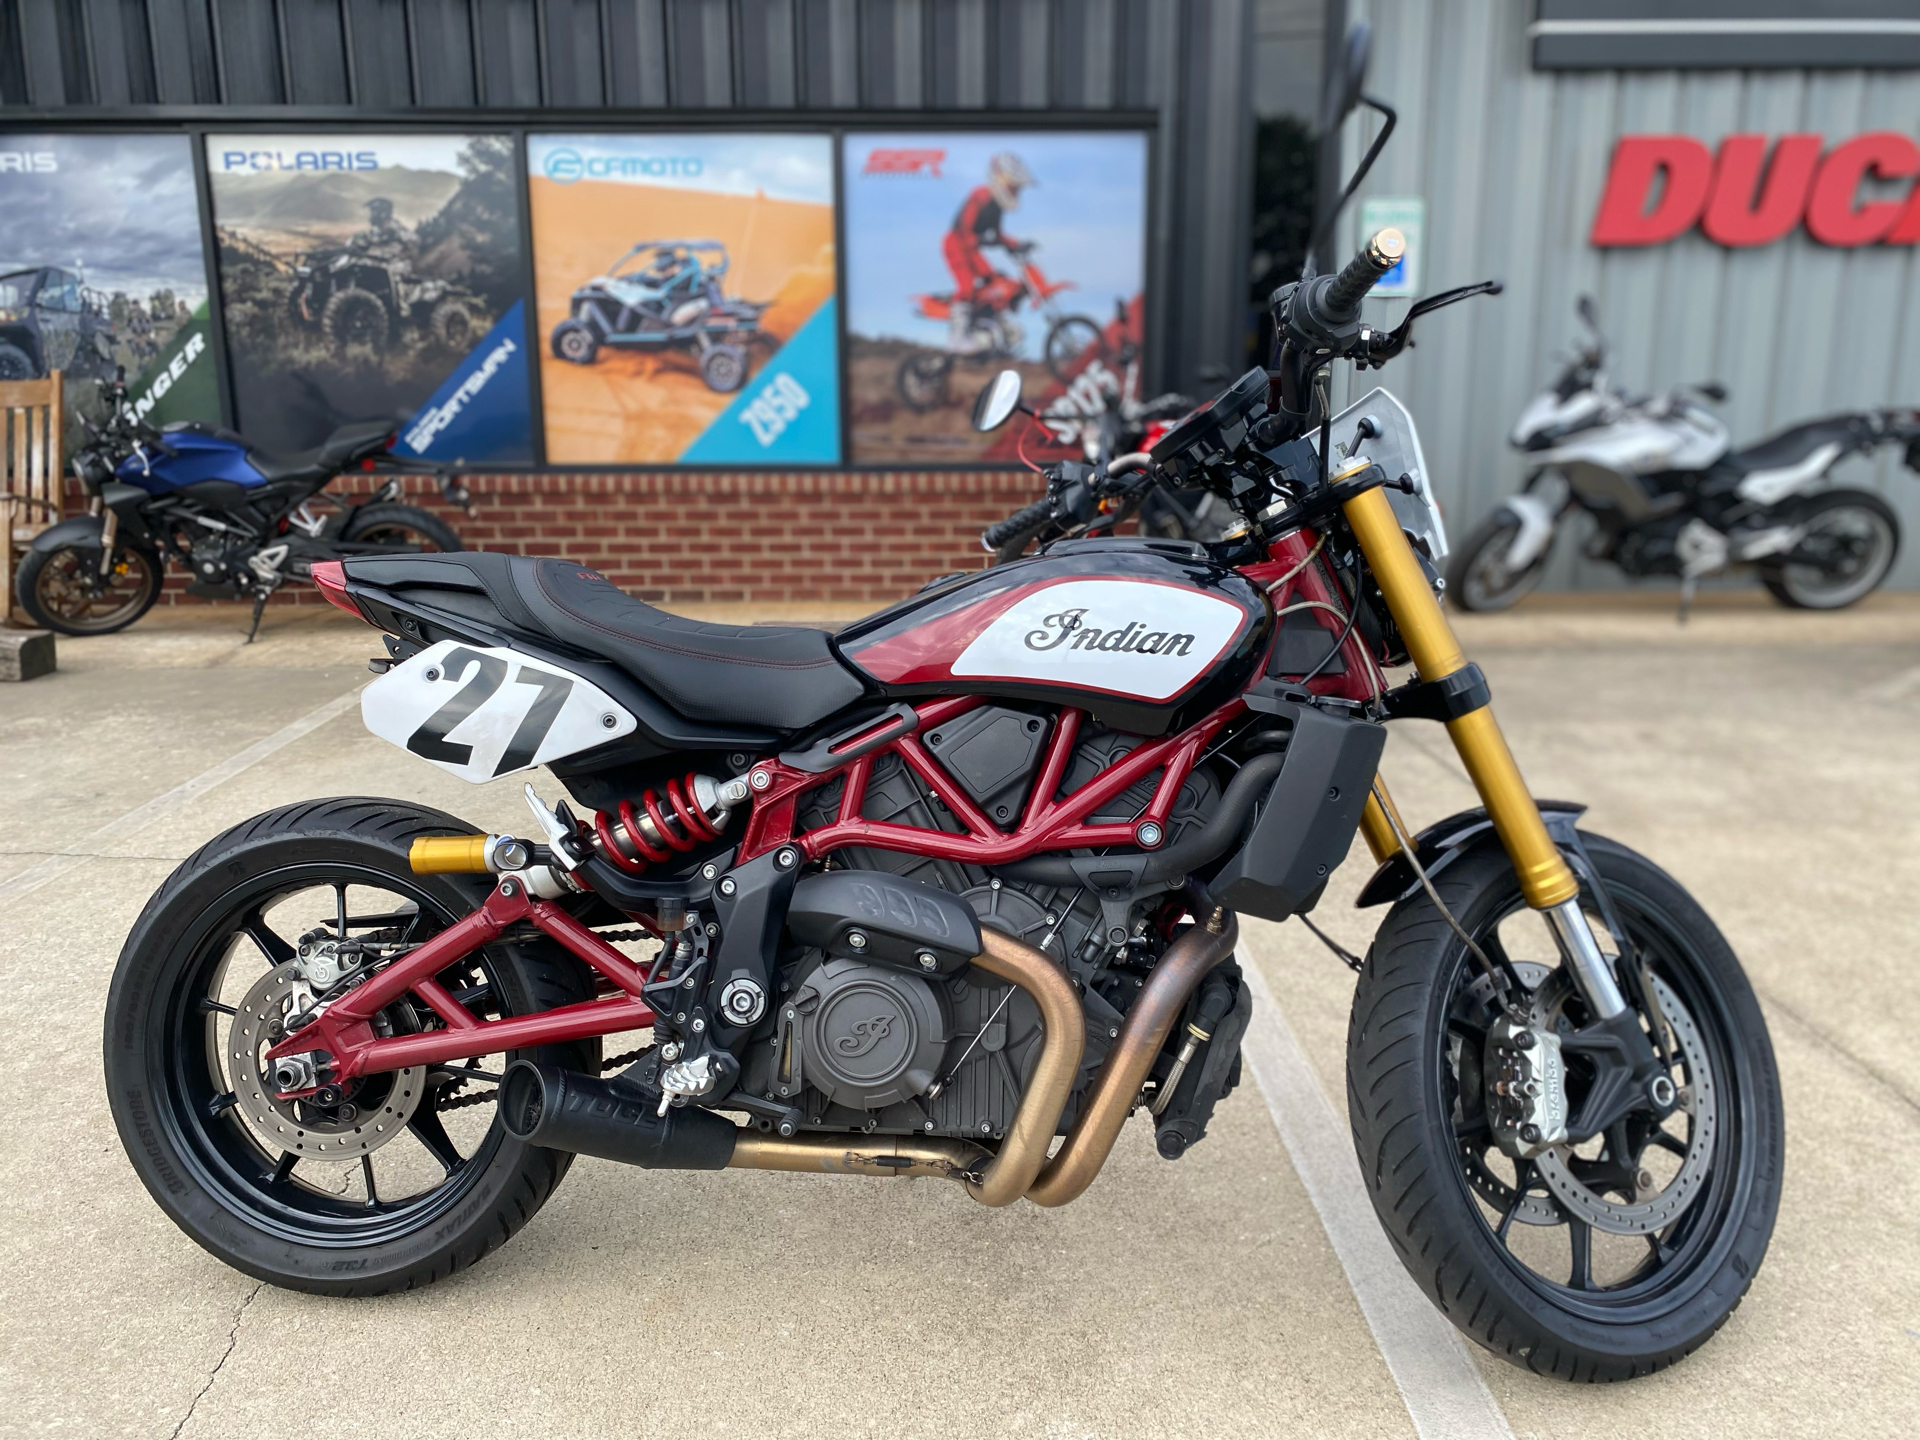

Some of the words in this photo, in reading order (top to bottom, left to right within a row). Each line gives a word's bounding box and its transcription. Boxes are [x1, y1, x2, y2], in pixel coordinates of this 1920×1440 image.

[0, 152, 58, 172] RIS
[223, 151, 379, 171] POLARIS
[587, 156, 703, 177] CFMOTO
[125, 332, 206, 426] NGER
[409, 337, 517, 455] SPORTSMAN
[1024, 608, 1196, 657] Indian
[406, 646, 574, 778] 27
[569, 1090, 661, 1129] TOCE
[1545, 1058, 1561, 1122] brembo
